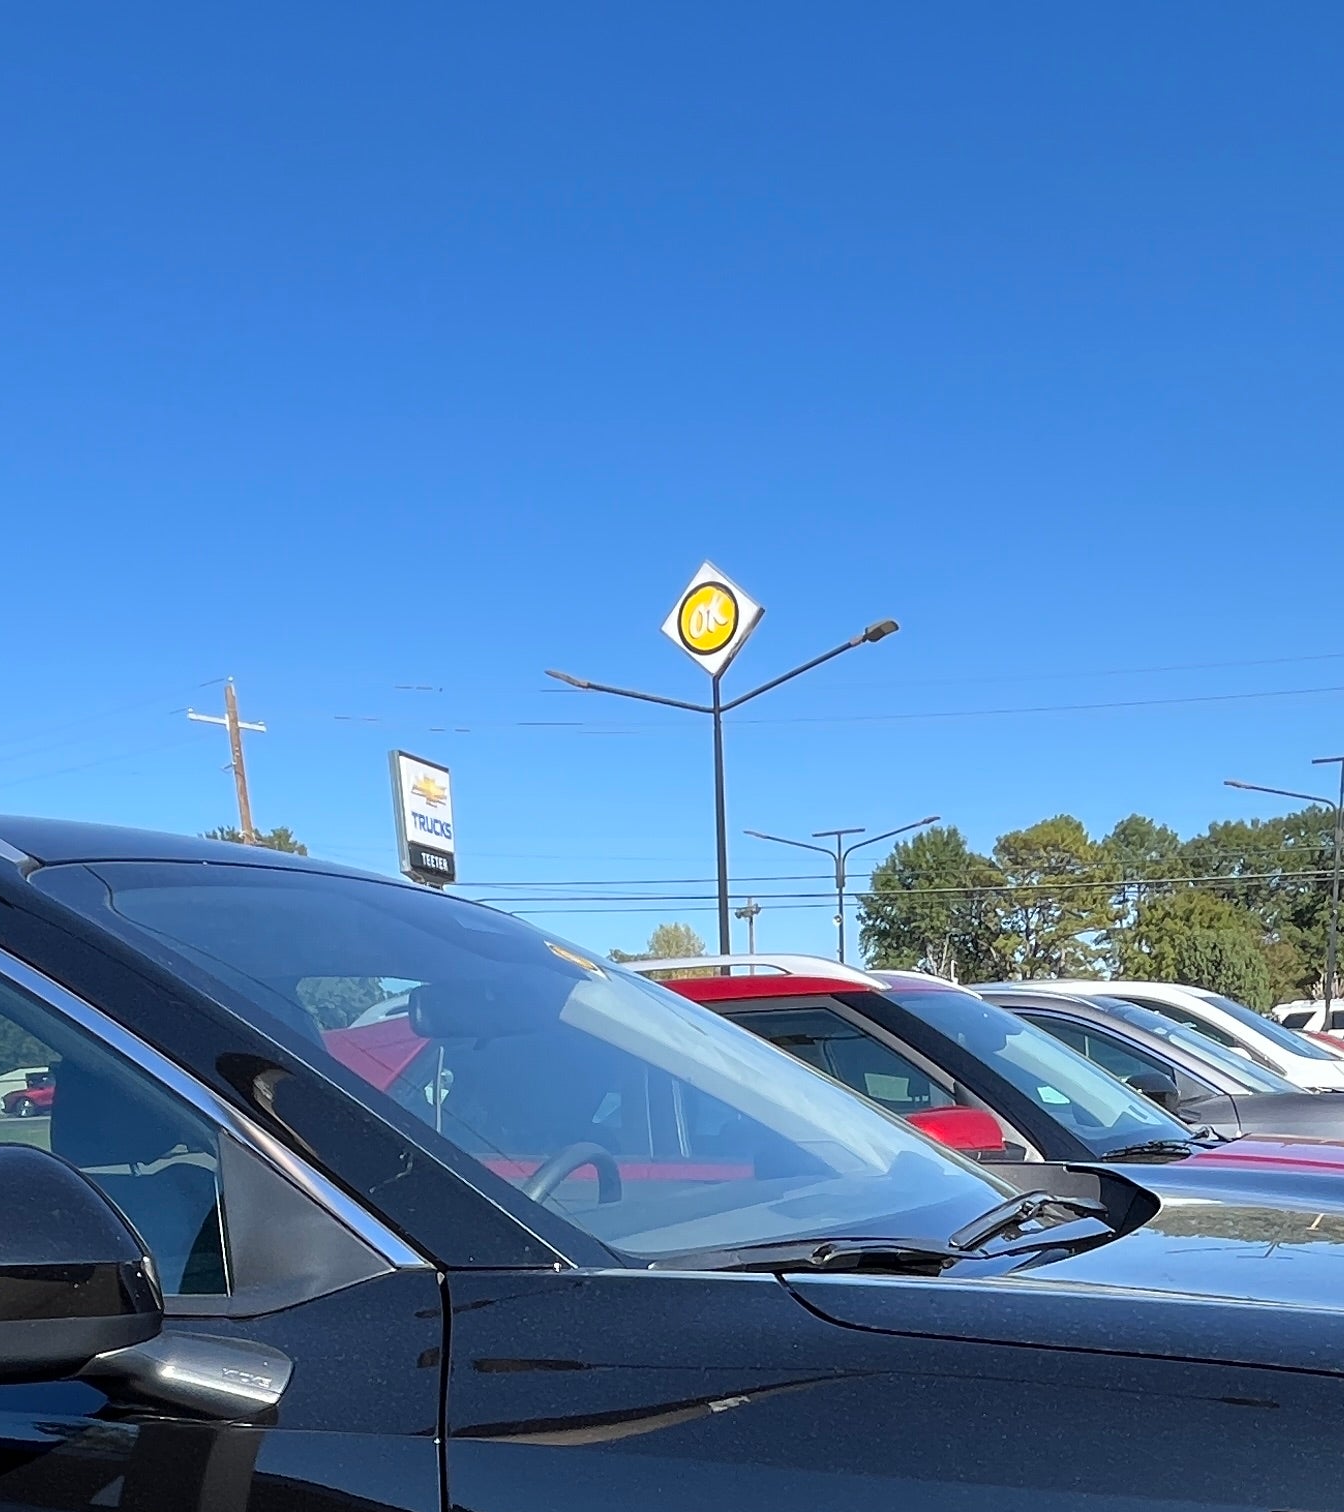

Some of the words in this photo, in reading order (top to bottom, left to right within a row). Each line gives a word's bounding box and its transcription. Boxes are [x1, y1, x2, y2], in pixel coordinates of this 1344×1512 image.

[689, 591, 730, 640] OK
[411, 810, 452, 840] TRUCKS
[421, 851, 449, 872] TEETER
